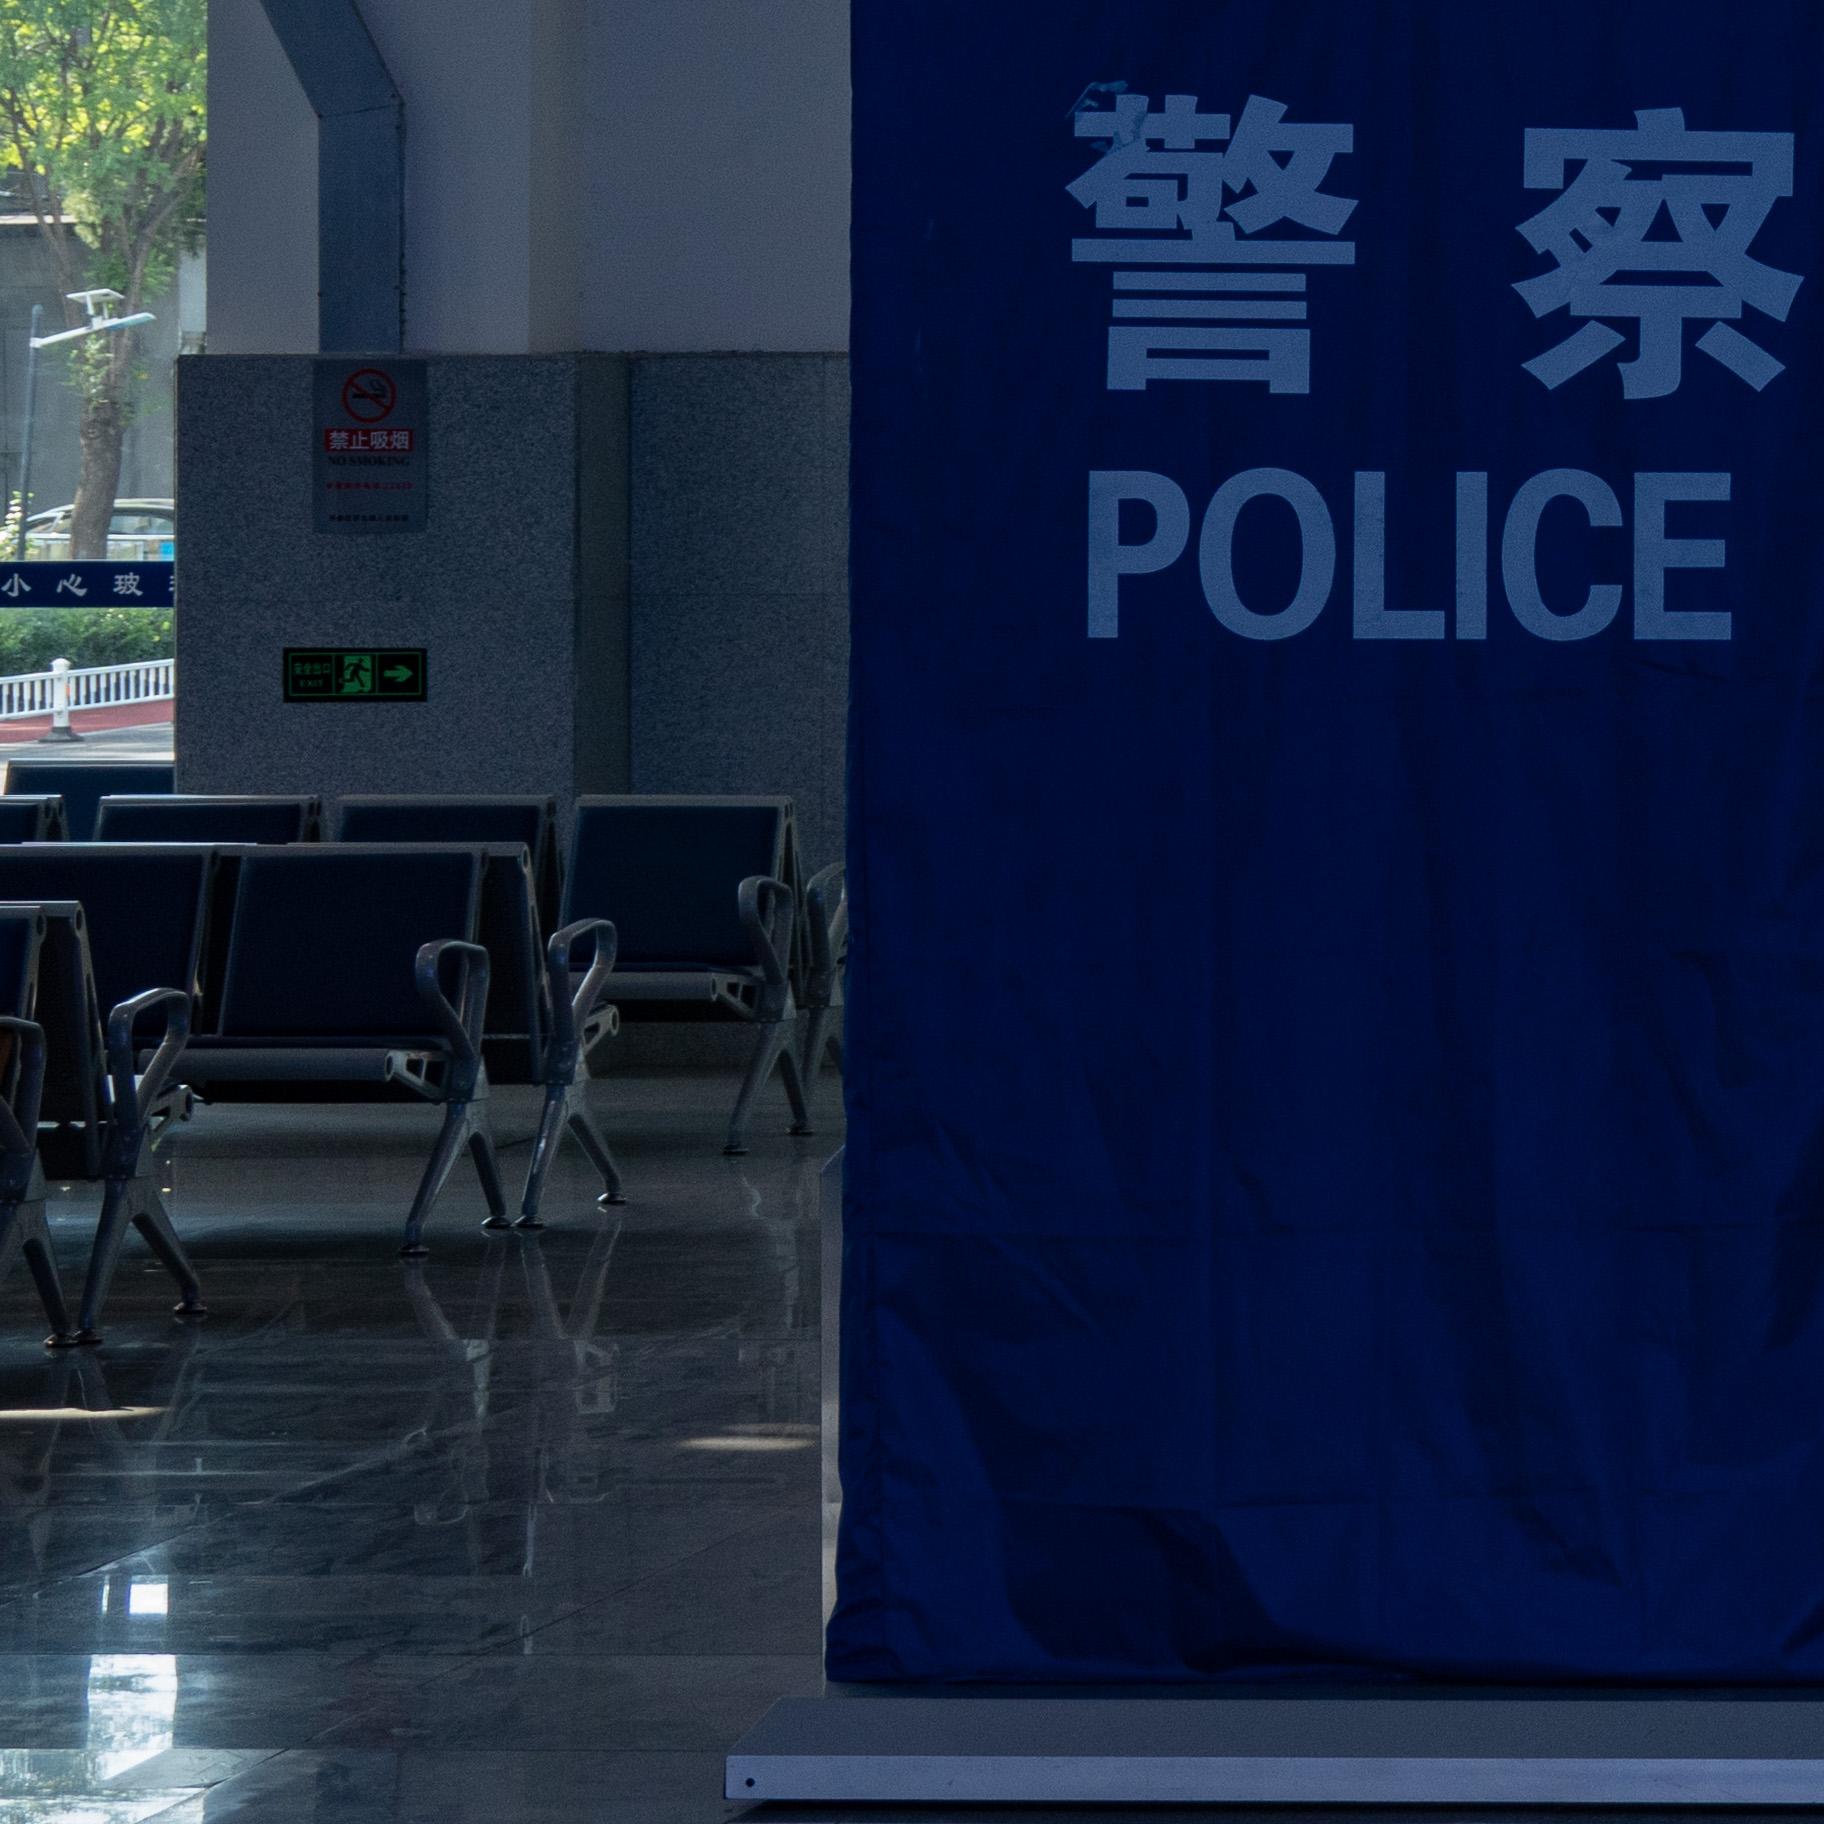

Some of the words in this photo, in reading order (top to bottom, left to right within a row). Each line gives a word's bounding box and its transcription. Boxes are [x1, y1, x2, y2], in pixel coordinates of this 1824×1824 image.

[1064, 84, 1805, 400] 警察
[328, 430, 410, 451] 禁止吸烟
[0, 571, 175, 598] 小心玻
[1086, 466, 1733, 641] POLICE
